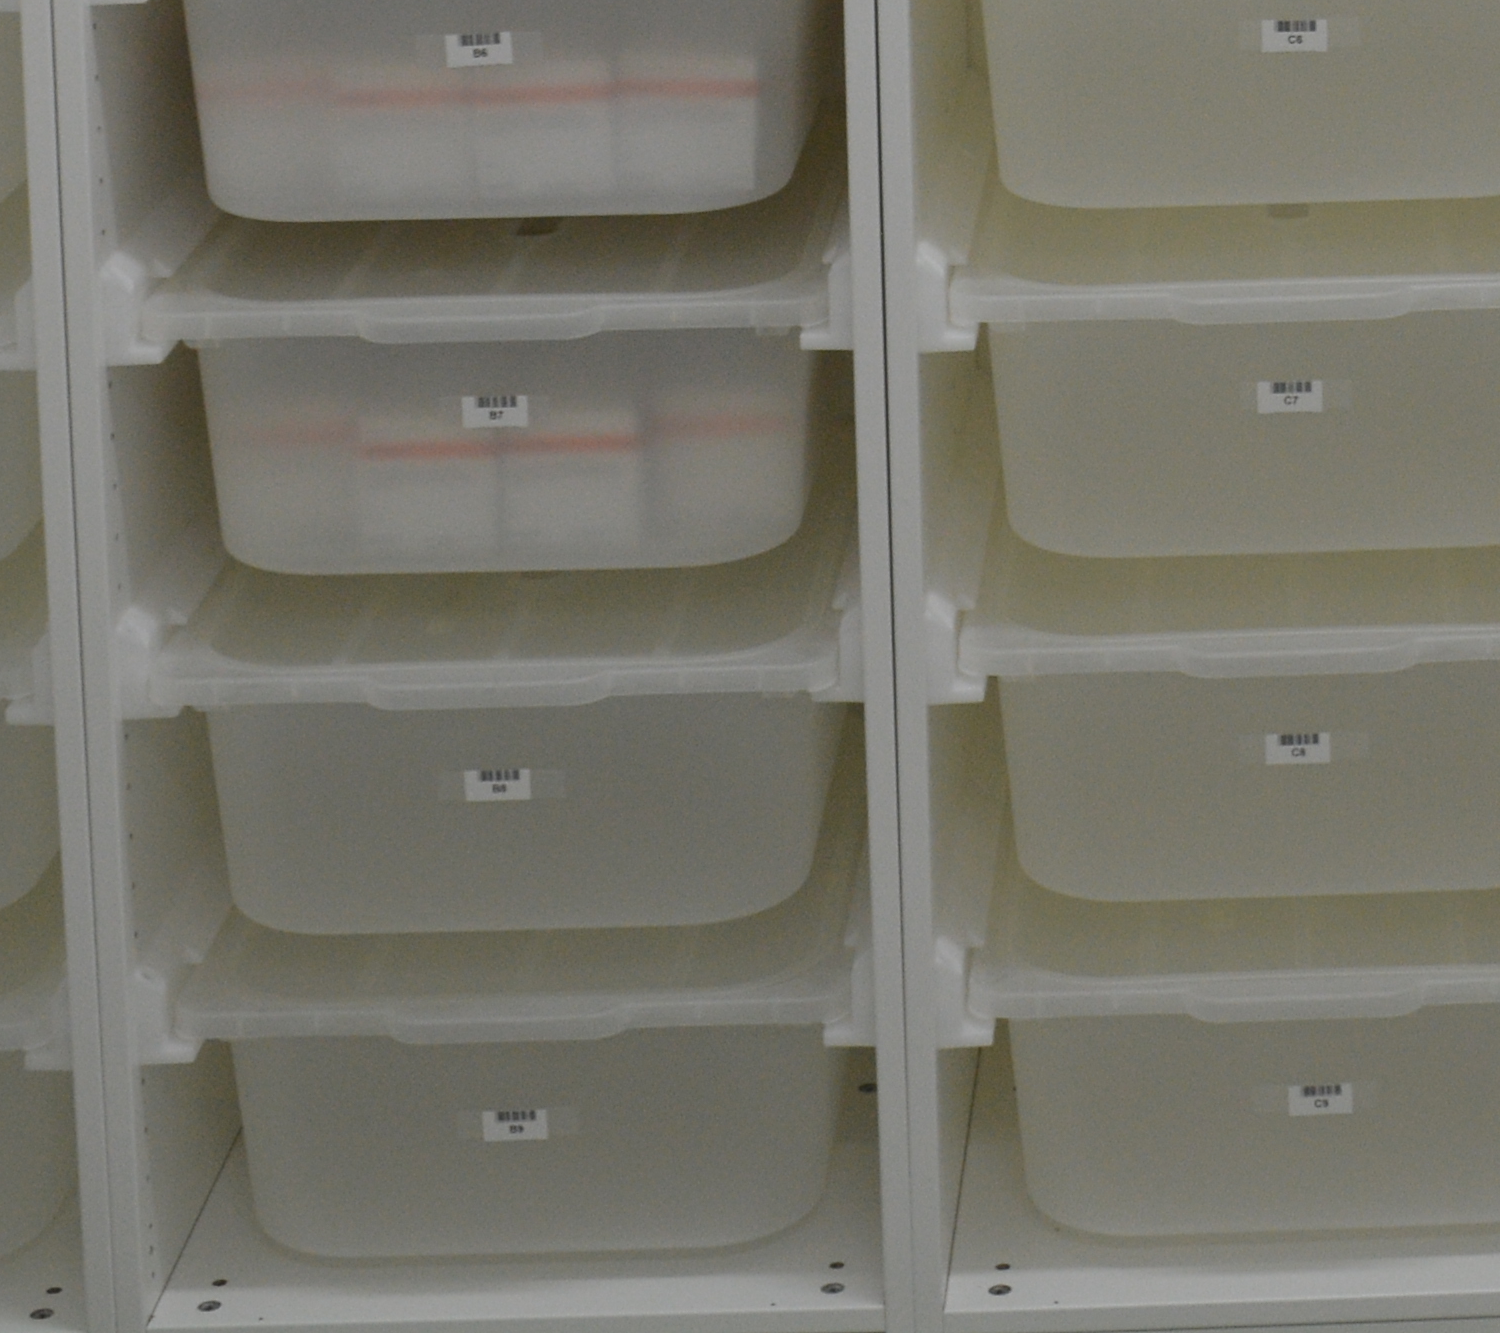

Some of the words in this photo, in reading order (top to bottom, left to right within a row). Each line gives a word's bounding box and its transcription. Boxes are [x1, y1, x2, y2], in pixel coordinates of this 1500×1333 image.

[1287, 34, 1304, 45] C6
[472, 47, 489, 59] B6
[1283, 394, 1300, 406] C7
[488, 409, 505, 421] B7
[1313, 1098, 1330, 1109] C9
